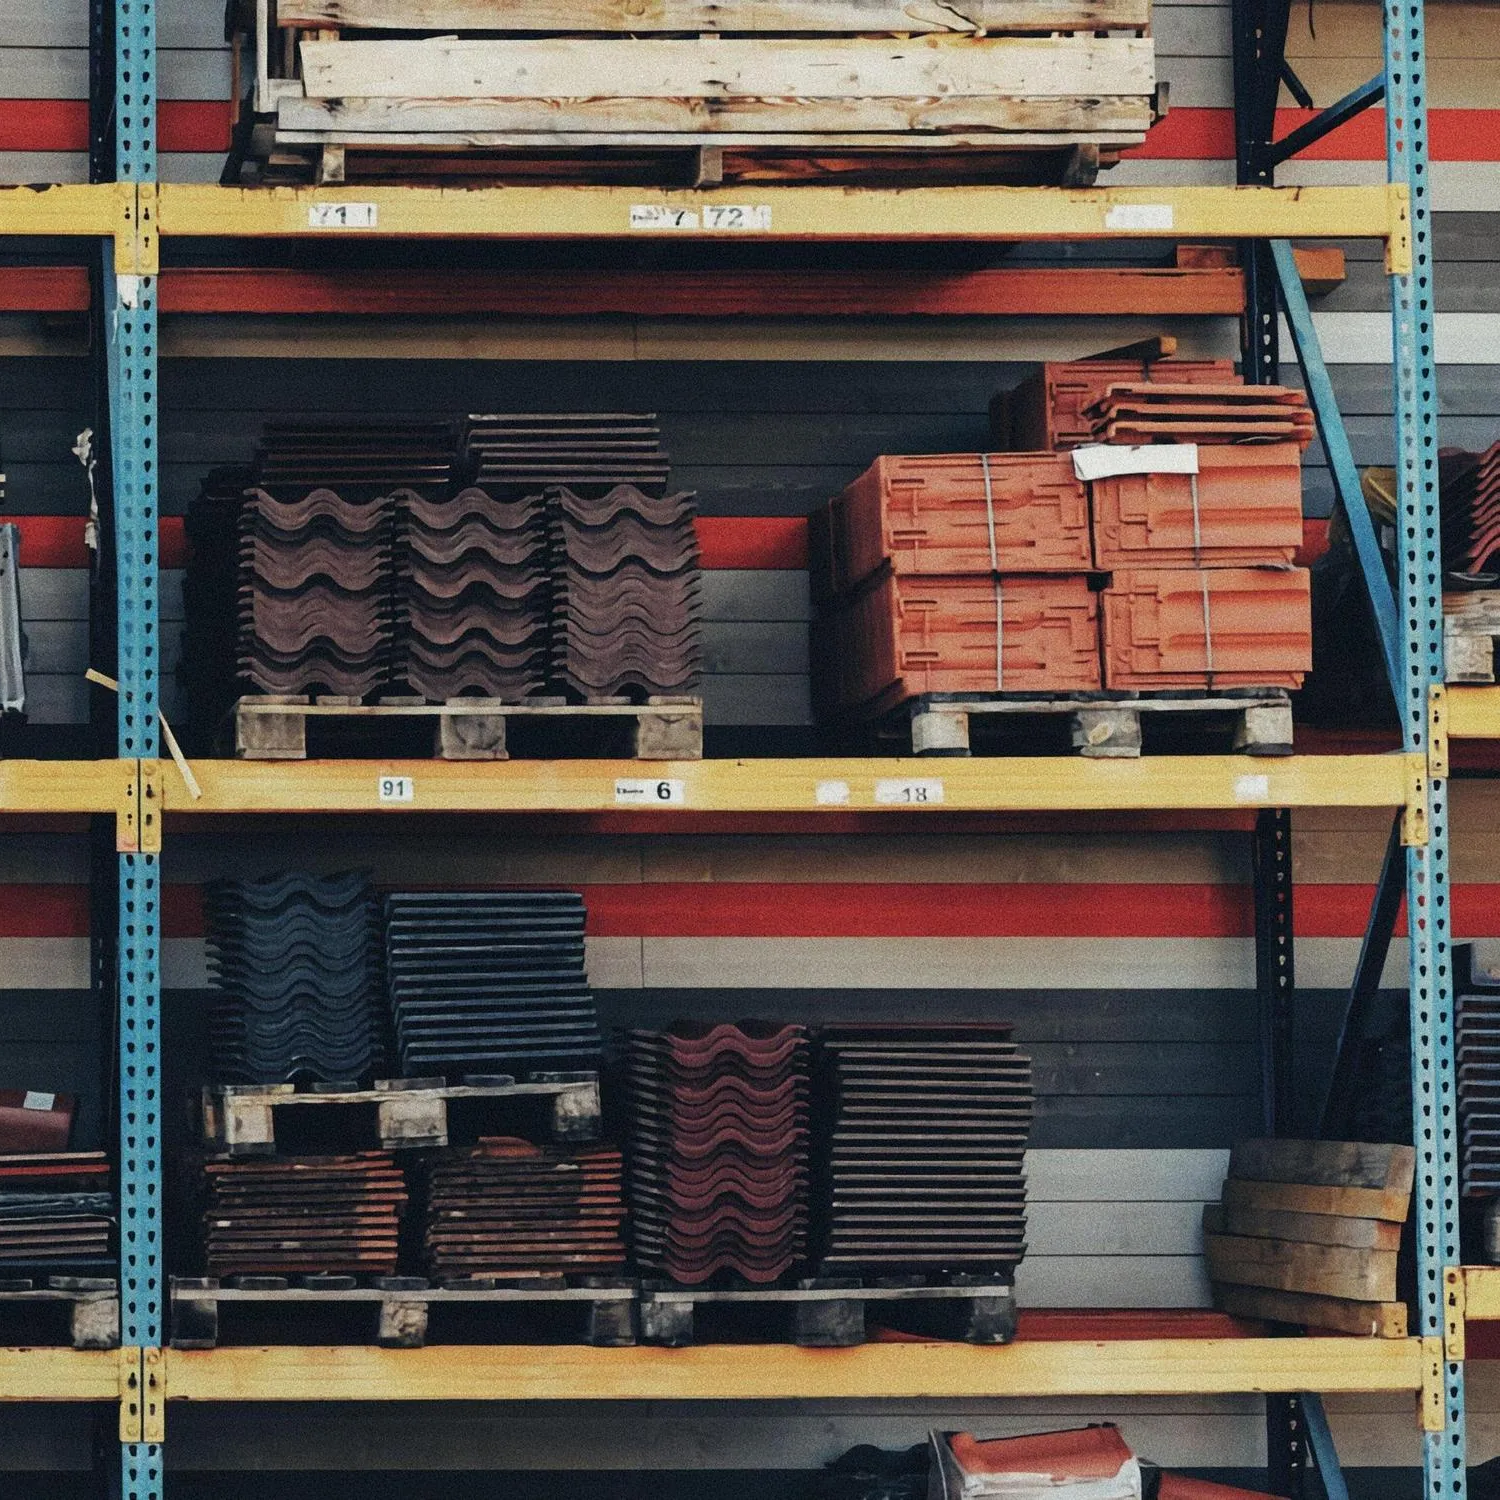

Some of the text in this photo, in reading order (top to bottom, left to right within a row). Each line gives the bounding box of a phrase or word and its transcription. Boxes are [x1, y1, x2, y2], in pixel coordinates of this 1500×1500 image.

[710, 208, 743, 227] 72
[383, 780, 404, 797] 91
[657, 782, 671, 799] 6
[902, 788, 927, 803] 18
